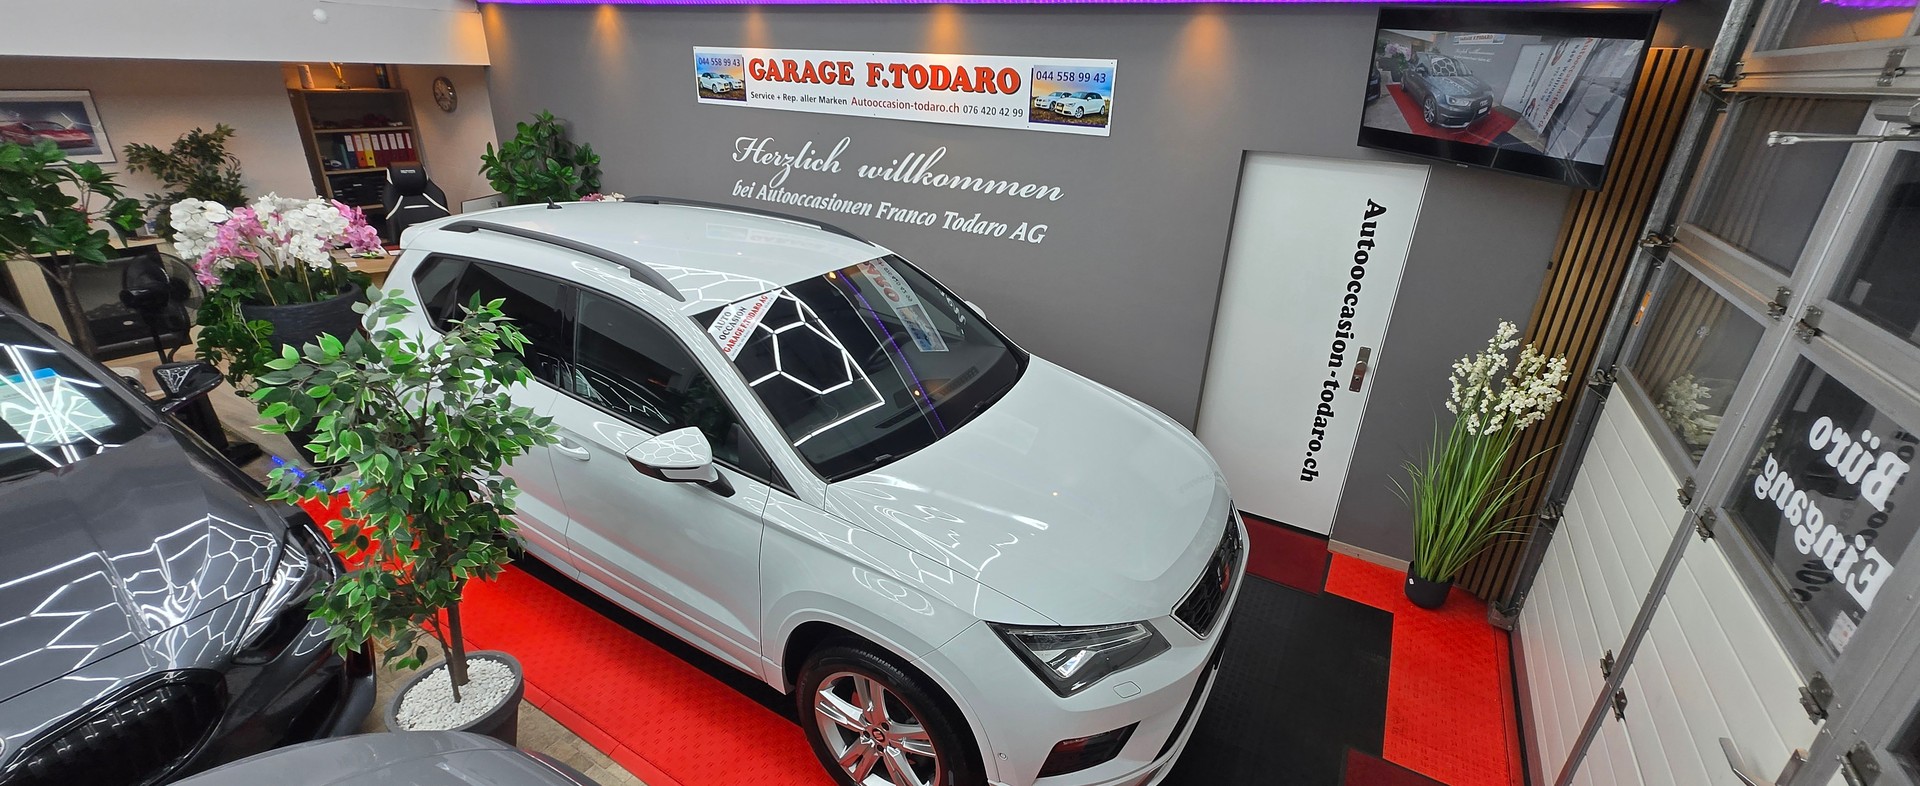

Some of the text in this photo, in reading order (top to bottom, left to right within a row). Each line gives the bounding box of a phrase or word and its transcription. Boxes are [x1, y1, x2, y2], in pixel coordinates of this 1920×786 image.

[698, 57, 741, 67] 044 558 99 43
[748, 57, 1022, 95] GARAGE F.TODARO
[1036, 70, 1106, 84] 044 558 99 43
[751, 91, 776, 101] Service
[782, 93, 799, 104] Rep.
[800, 94, 817, 104] aller
[819, 96, 848, 105] Marken
[850, 97, 960, 114] Autooccasion-todaro.ch
[962, 105, 979, 115] 076
[980, 106, 997, 116] 420
[998, 107, 1010, 117] 42
[1012, 108, 1024, 118] 99
[732, 136, 1065, 201] Herzlich willkommen
[732, 179, 1048, 244] bei Autooccasionen Franco Todaro AG
[714, 311, 732, 331] AUTO
[719, 306, 747, 341] OCCASION
[723, 323, 744, 353] GARAGE
[1300, 198, 1387, 482] Autooccasion-todaro.ch
